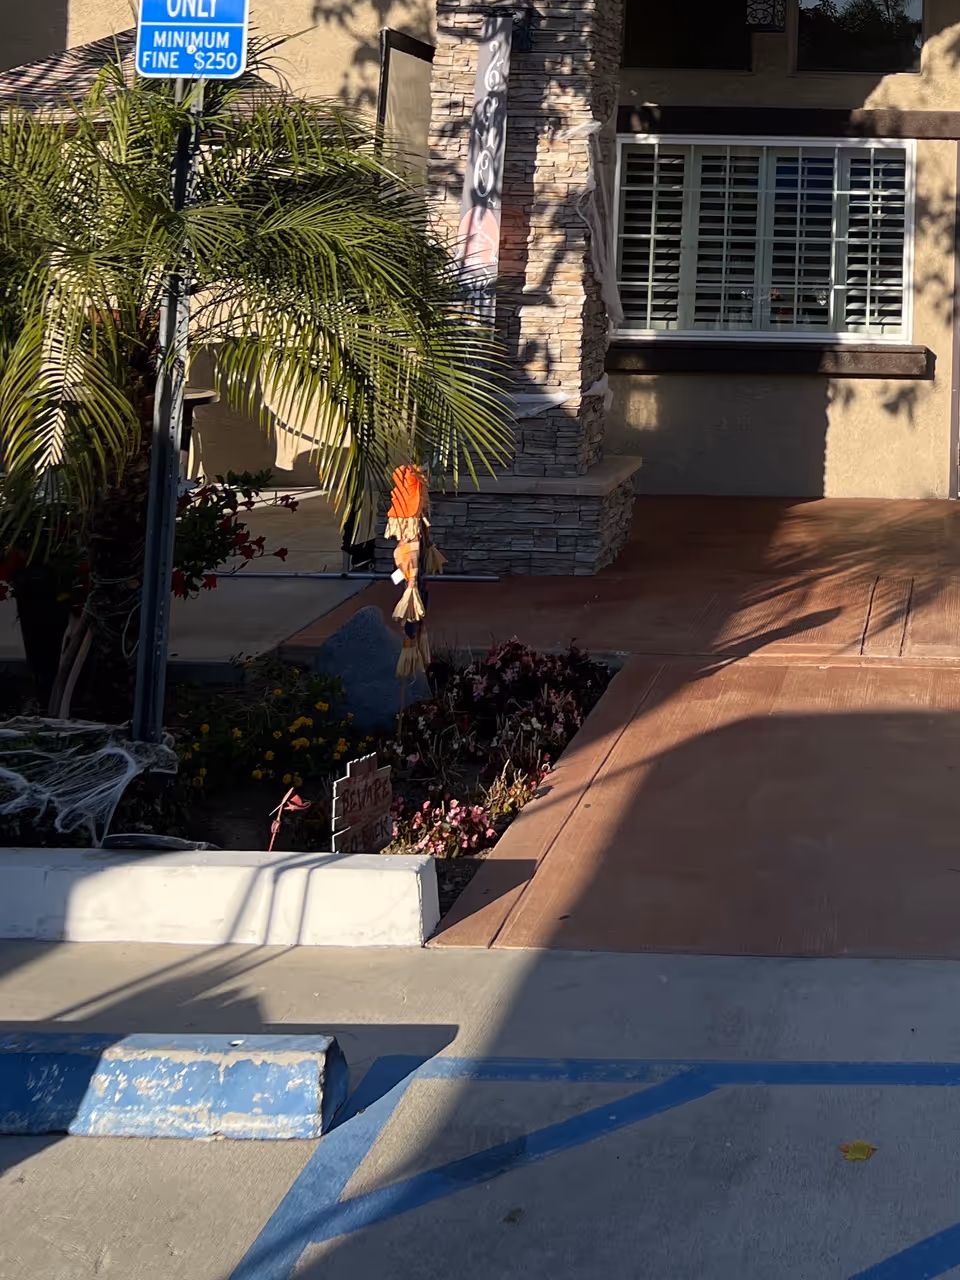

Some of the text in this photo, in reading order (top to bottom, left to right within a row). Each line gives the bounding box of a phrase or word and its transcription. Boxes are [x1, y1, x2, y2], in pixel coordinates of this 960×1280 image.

[153, 30, 230, 49] MINIMUM
[142, 51, 238, 71] FINE $250
[339, 776, 391, 816] BEWARE
